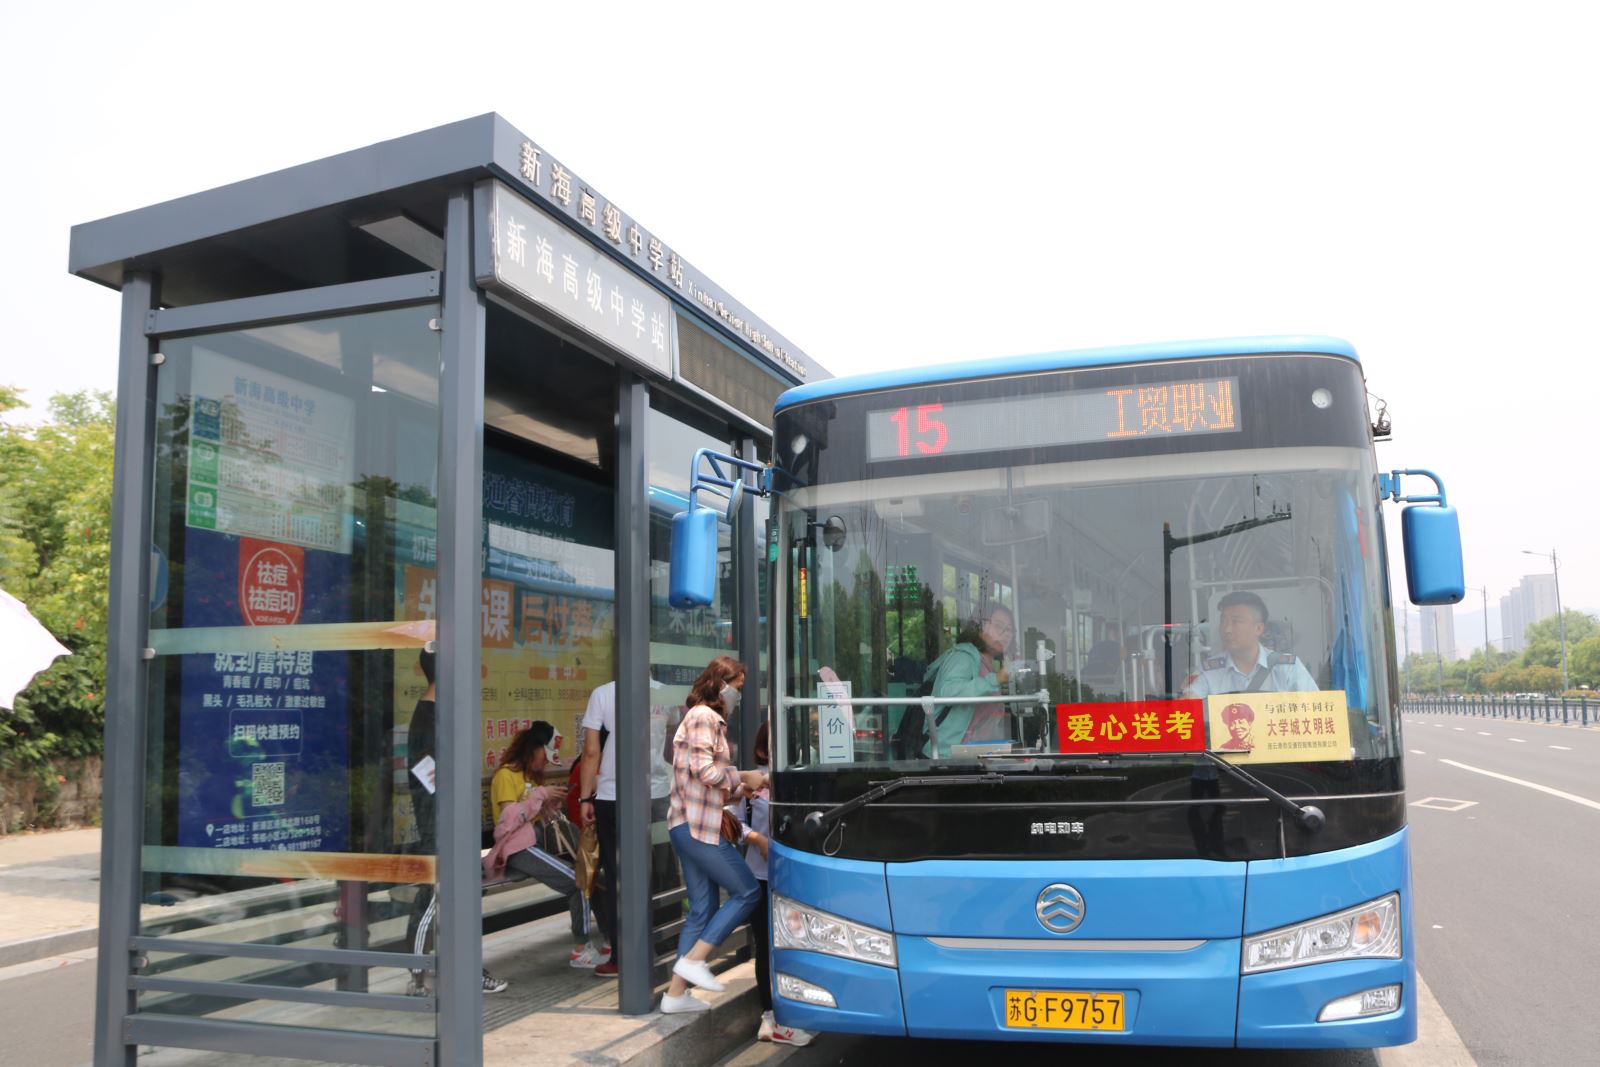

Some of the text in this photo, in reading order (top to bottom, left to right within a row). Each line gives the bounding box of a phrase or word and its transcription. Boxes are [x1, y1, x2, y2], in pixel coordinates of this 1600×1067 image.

[520, 141, 683, 289] 新海高级中学站
[507, 216, 665, 352] 新海高级中学站
[234, 376, 316, 417] 新海高级中学
[1106, 380, 1235, 437] 工贸职业
[890, 404, 949, 457] 15
[257, 560, 288, 586] 祛痘
[249, 586, 295, 614] 祛痘印
[1264, 702, 1334, 715] 与雷锋车同行
[233, 724, 300, 740] 扫码快速预约
[1067, 711, 1195, 743] 爱心送考
[1267, 717, 1336, 737] 大学城文明线
